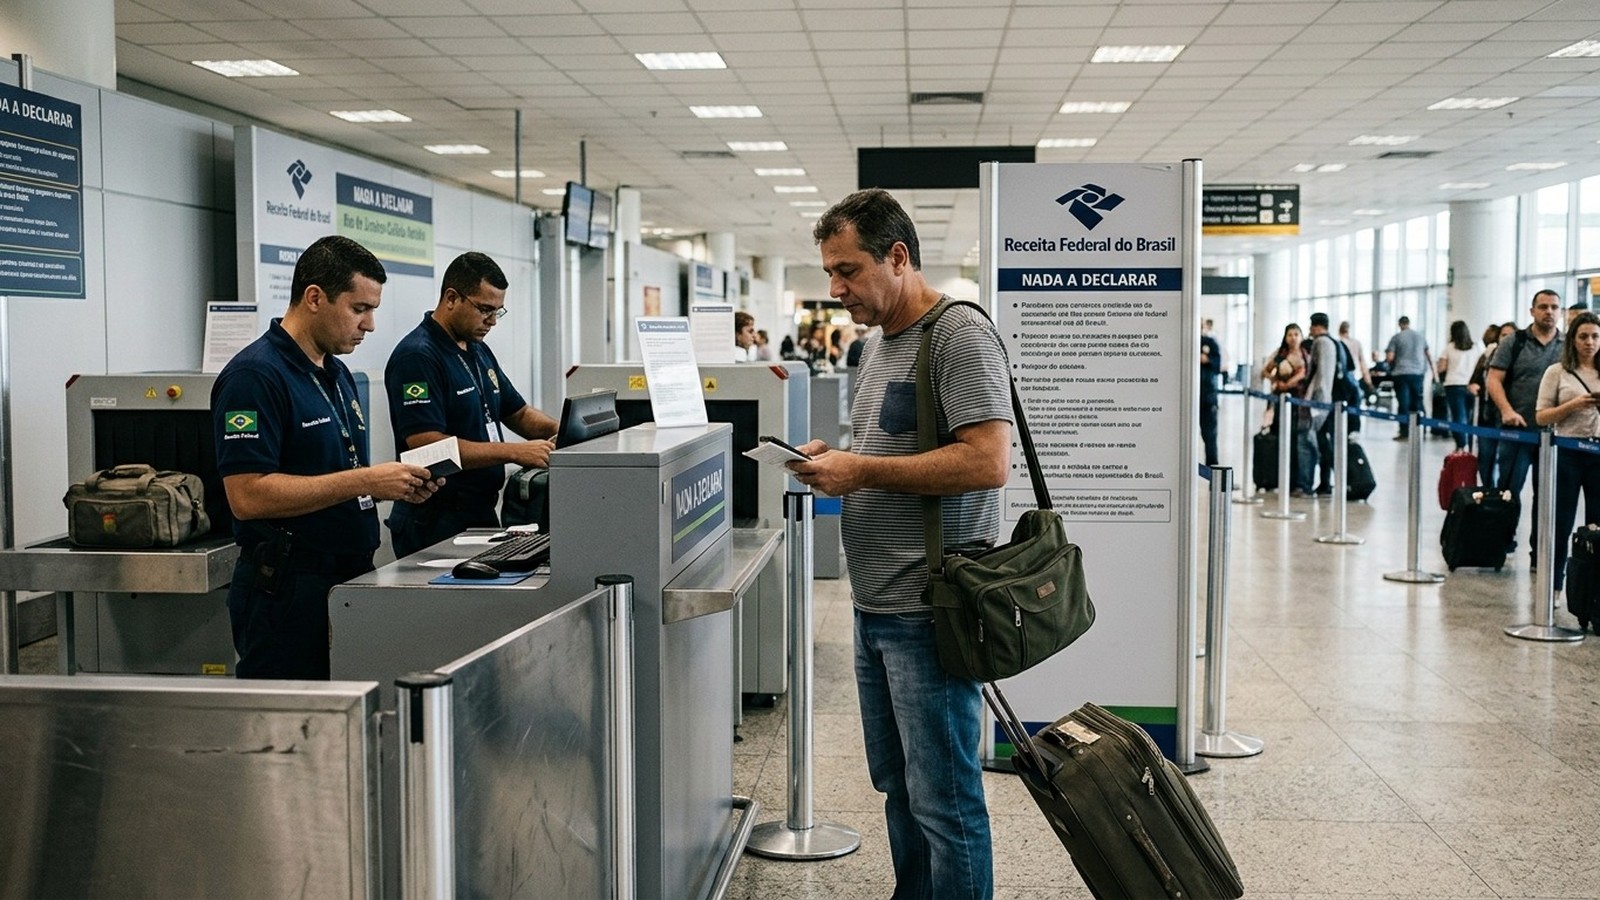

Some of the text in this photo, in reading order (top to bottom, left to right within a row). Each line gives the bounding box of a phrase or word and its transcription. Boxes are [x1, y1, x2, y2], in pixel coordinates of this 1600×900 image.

[0, 98, 73, 129] A A DECLARAR
[1004, 237, 1175, 252] Receita Federal do Brasil
[1022, 273, 1157, 286] NADA A DECLARAR
